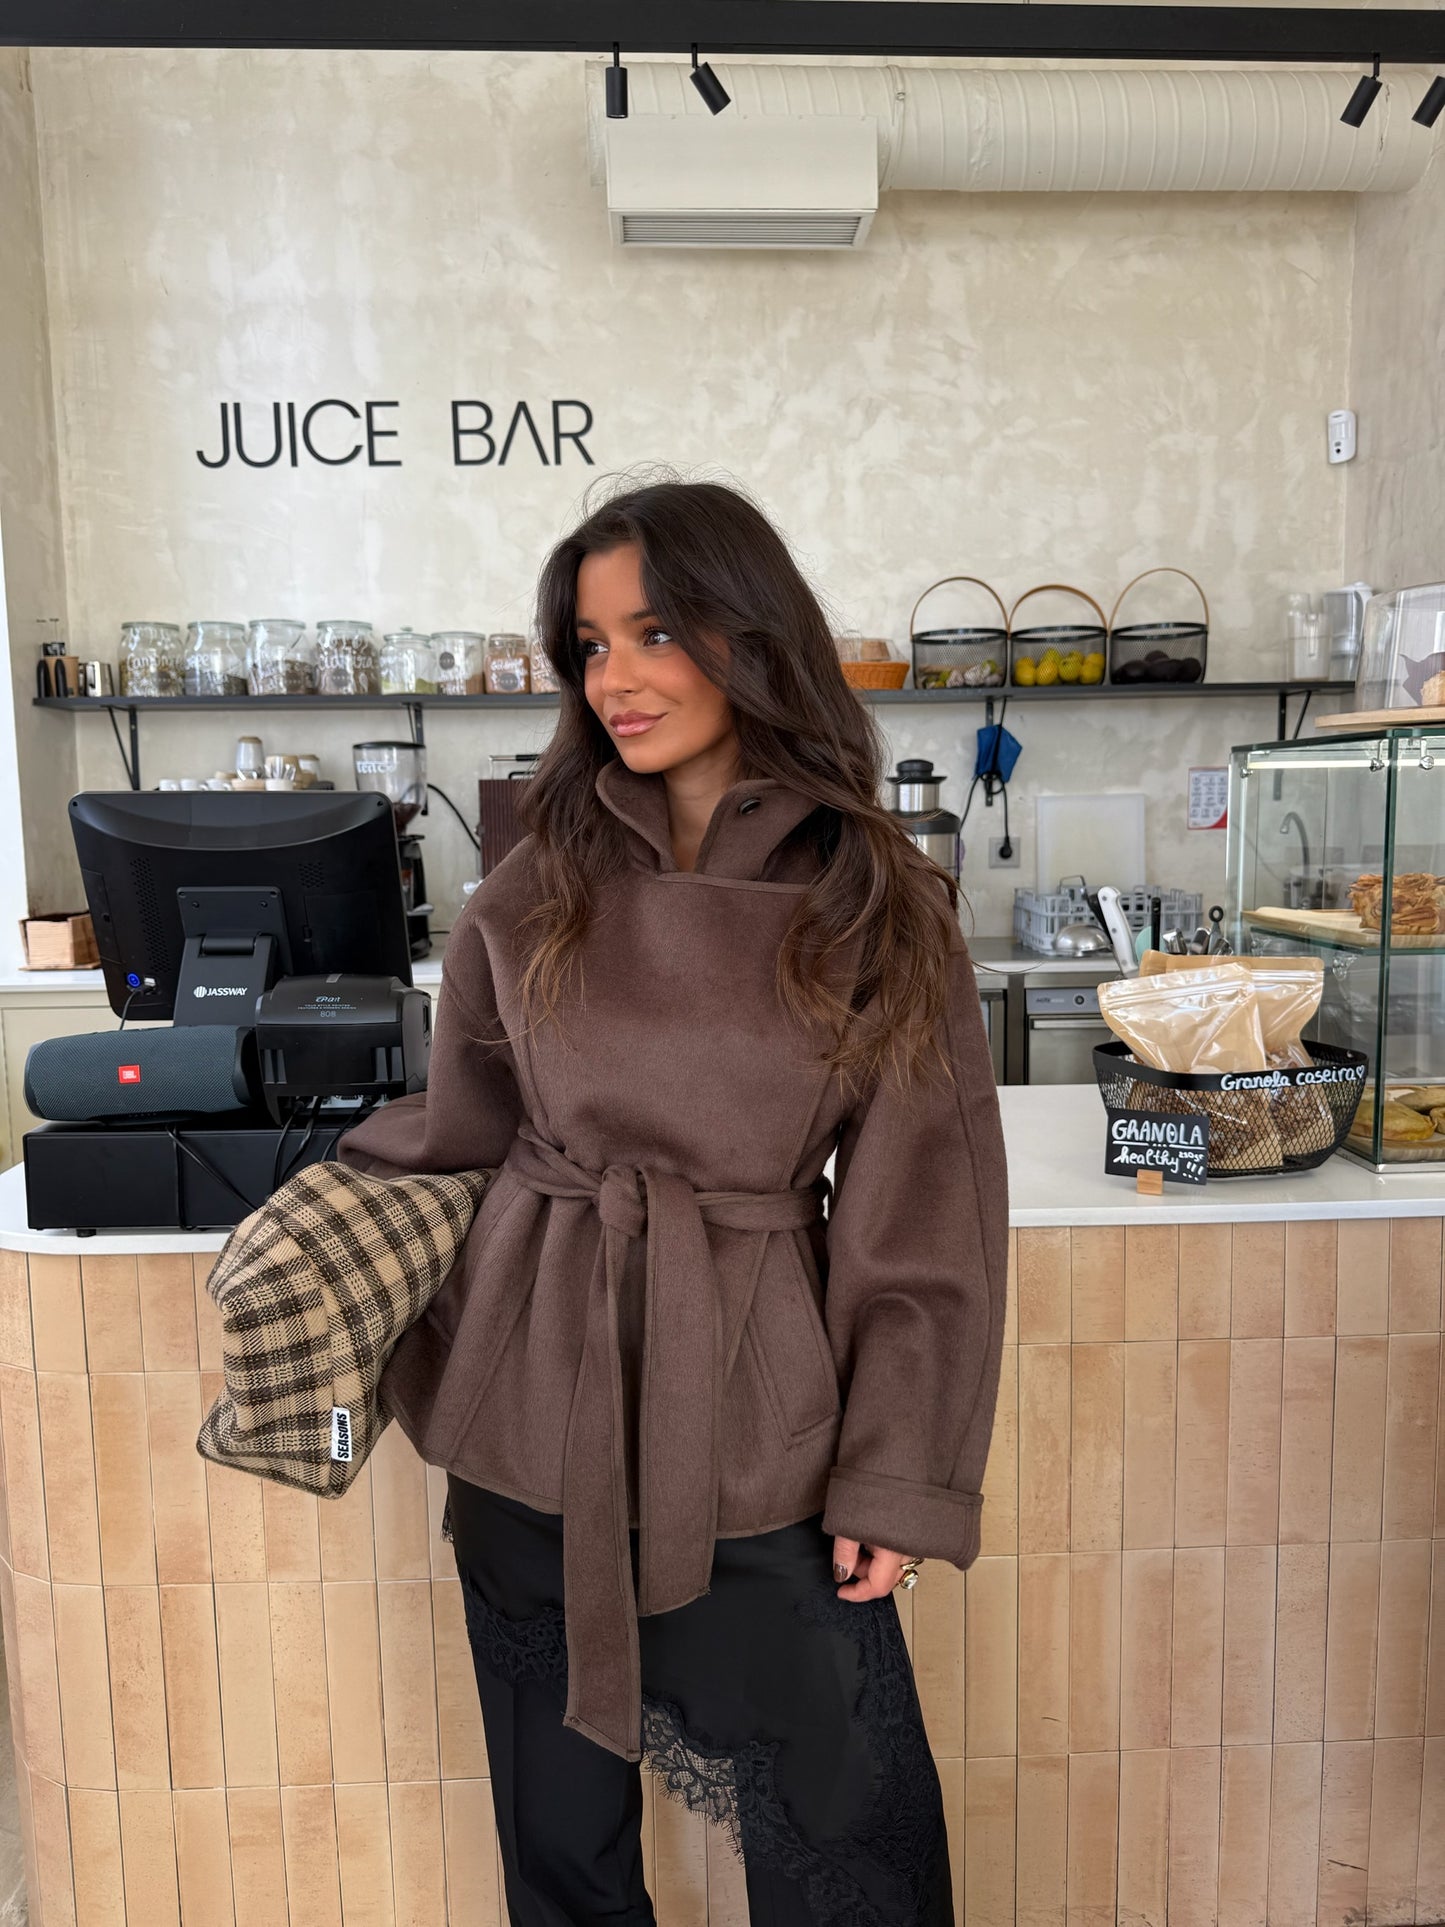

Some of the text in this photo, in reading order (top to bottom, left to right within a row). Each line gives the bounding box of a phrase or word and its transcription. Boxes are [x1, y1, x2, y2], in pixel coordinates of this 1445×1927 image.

[196, 399, 595, 468] JUICE BAR
[207, 987, 248, 996] JASSWAY
[1220, 1066, 1357, 1091] Granola caseira
[1111, 1119, 1204, 1145] GRANOLA
[1113, 1145, 1179, 1174] healthy
[336, 1412, 350, 1459] SEASONS
